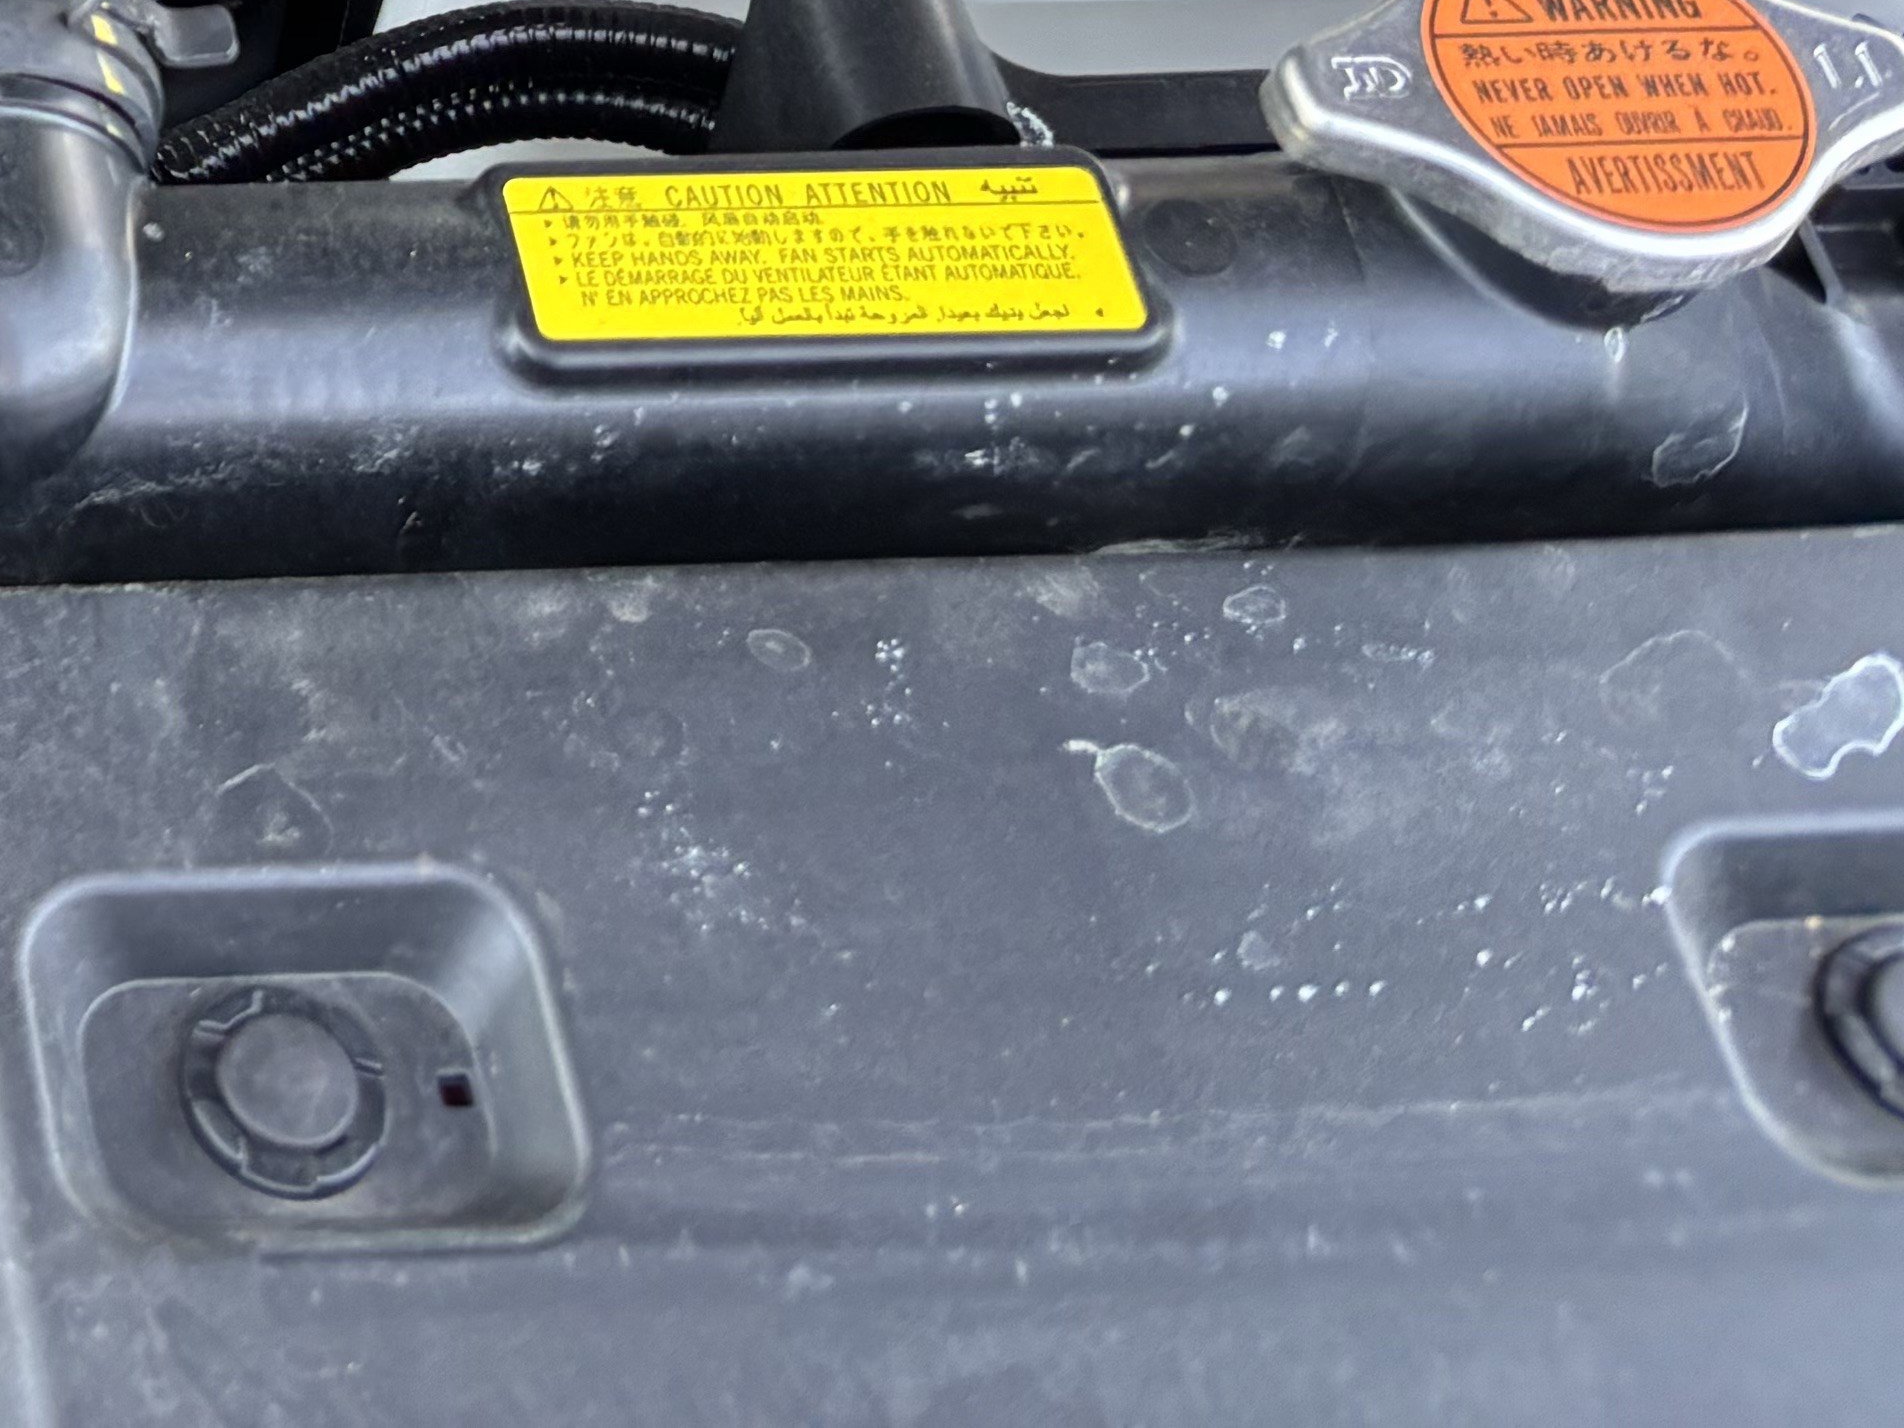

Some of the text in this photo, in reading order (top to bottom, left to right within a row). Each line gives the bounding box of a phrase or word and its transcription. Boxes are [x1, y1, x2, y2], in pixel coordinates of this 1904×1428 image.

[1473, 69, 1778, 105] NEVER OPEN WHEN HOT.
[1491, 116, 1520, 141] NE
[1533, 112, 1602, 139] JAMAIS
[1567, 150, 1767, 198] AVERTISSMENT
[664, 179, 953, 209] CAUTION ATTENTION
[572, 242, 1076, 268] KEEP HANDS AWAY. FAN STARTS AUTOMATICALLY.
[576, 261, 1081, 288] LE DÉMARRAGE DU VENTILATEUR ÉTANT AUTOMATIQUE.
[606, 289, 633, 306] EN
[639, 287, 751, 306] APPROCHEZ
[758, 287, 794, 304] PAS
[797, 287, 833, 303] LES
[841, 285, 909, 302] MAINS.
